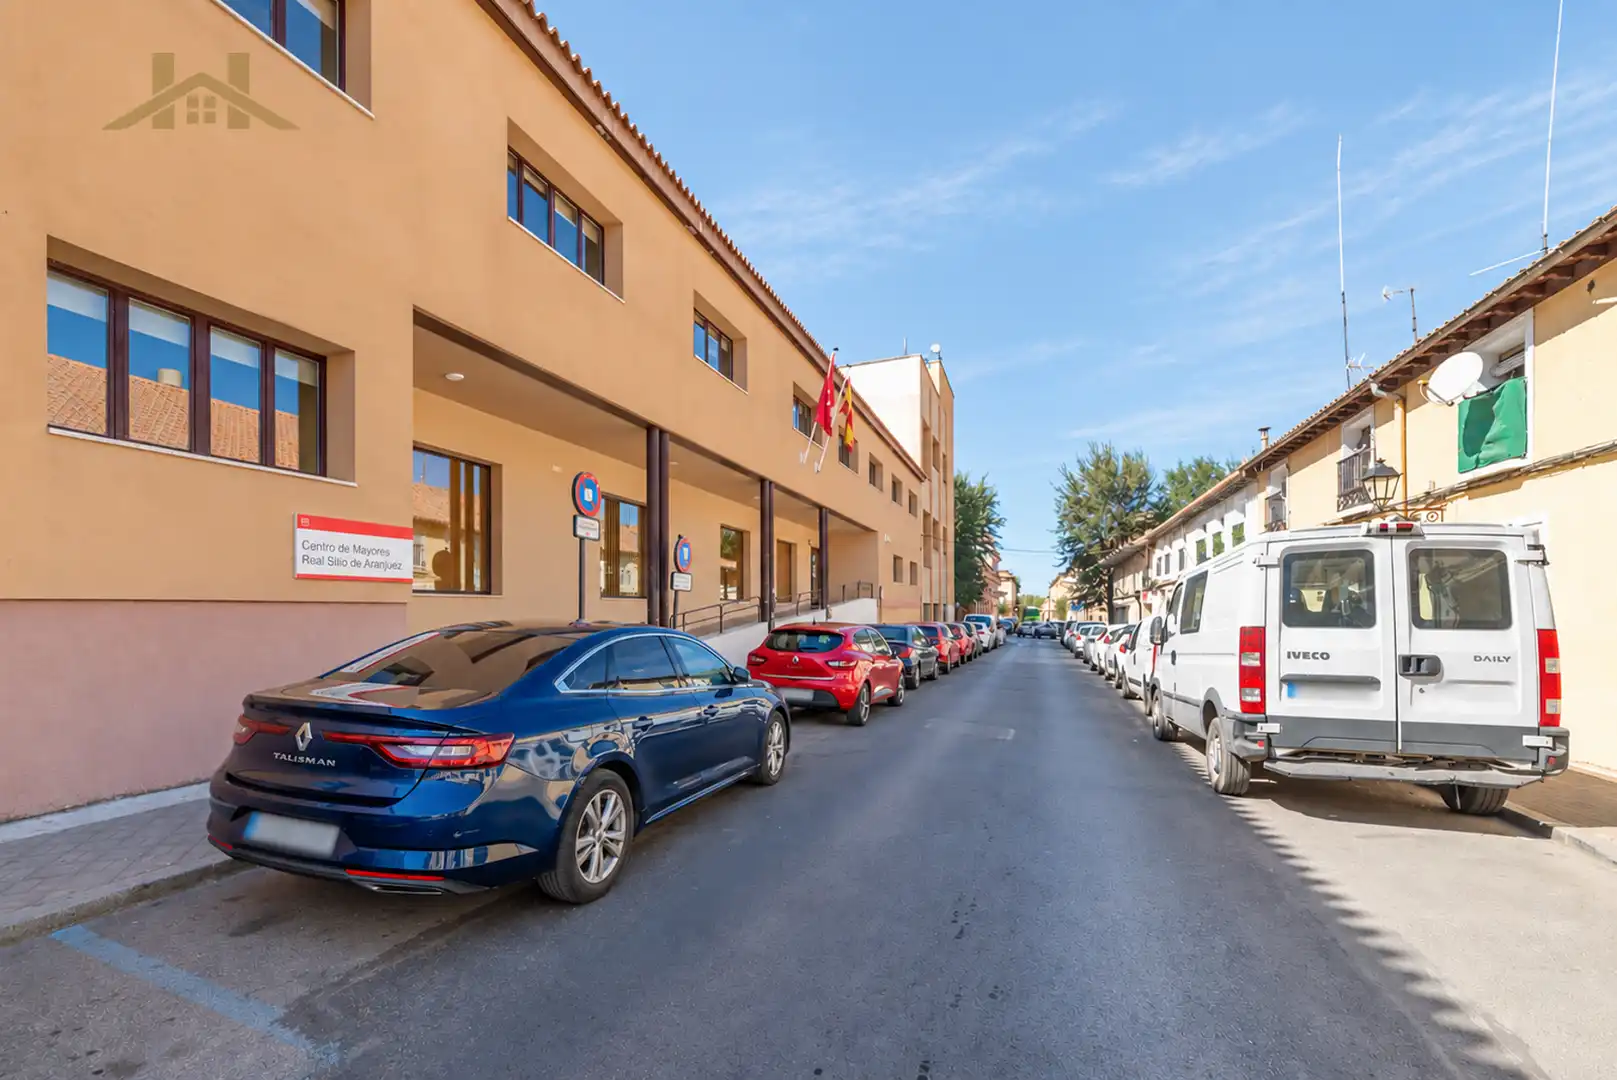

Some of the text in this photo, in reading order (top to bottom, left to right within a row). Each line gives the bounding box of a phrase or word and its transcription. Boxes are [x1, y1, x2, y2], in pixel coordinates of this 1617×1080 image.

[301, 540, 390, 557] Centro de Mayores
[301, 554, 325, 566] Real
[350, 558, 362, 568] de
[363, 559, 403, 572] Aranjuez
[1287, 651, 1330, 660] IVECO
[1473, 655, 1511, 663] DAILY
[273, 752, 336, 766] TALISMAN
